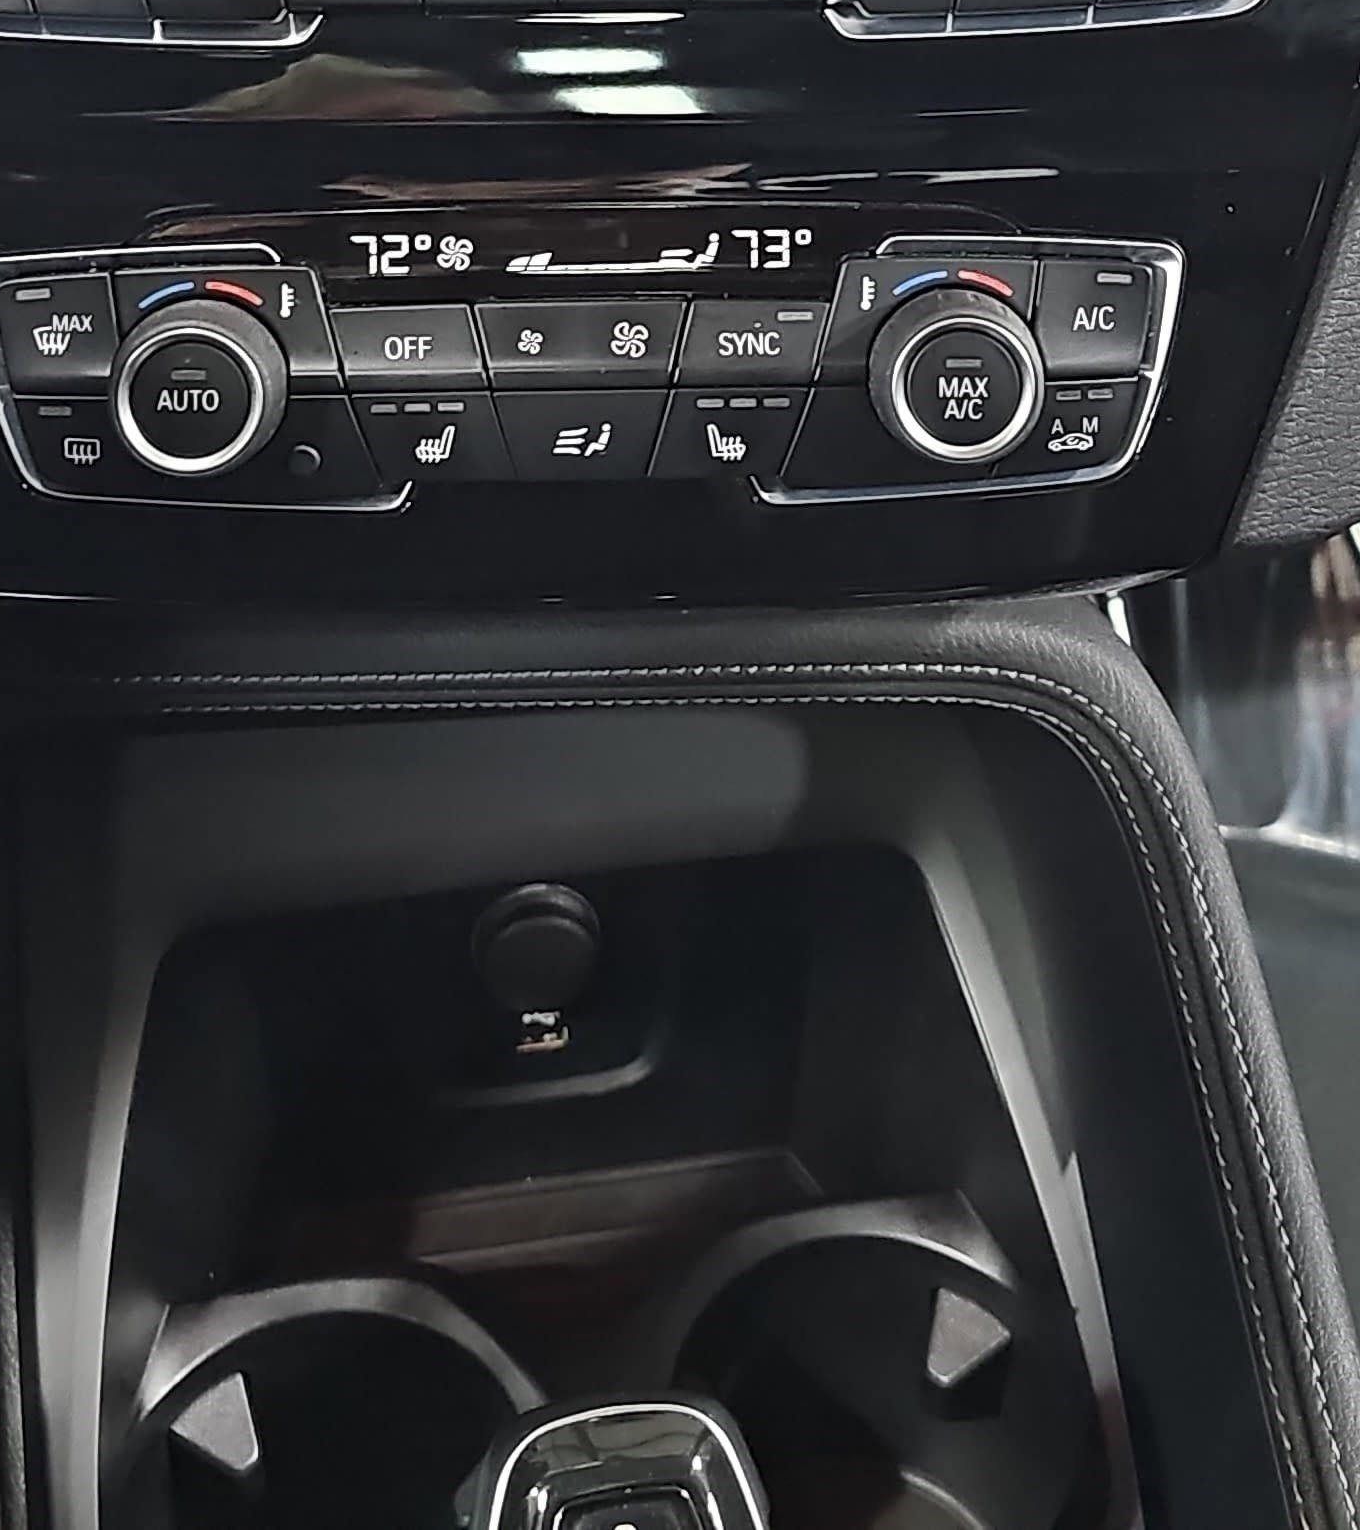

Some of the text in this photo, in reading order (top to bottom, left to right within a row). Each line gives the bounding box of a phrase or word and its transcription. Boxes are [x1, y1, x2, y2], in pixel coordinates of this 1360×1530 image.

[52, 313, 93, 333] MAX
[1073, 306, 1115, 331] A/C
[384, 336, 433, 360] OFF
[718, 331, 781, 357] SYNC
[939, 376, 988, 399] MAX
[156, 389, 220, 412] AUTO
[944, 399, 984, 420] A/C
[1051, 418, 1064, 435] A
[1082, 416, 1099, 434] M
